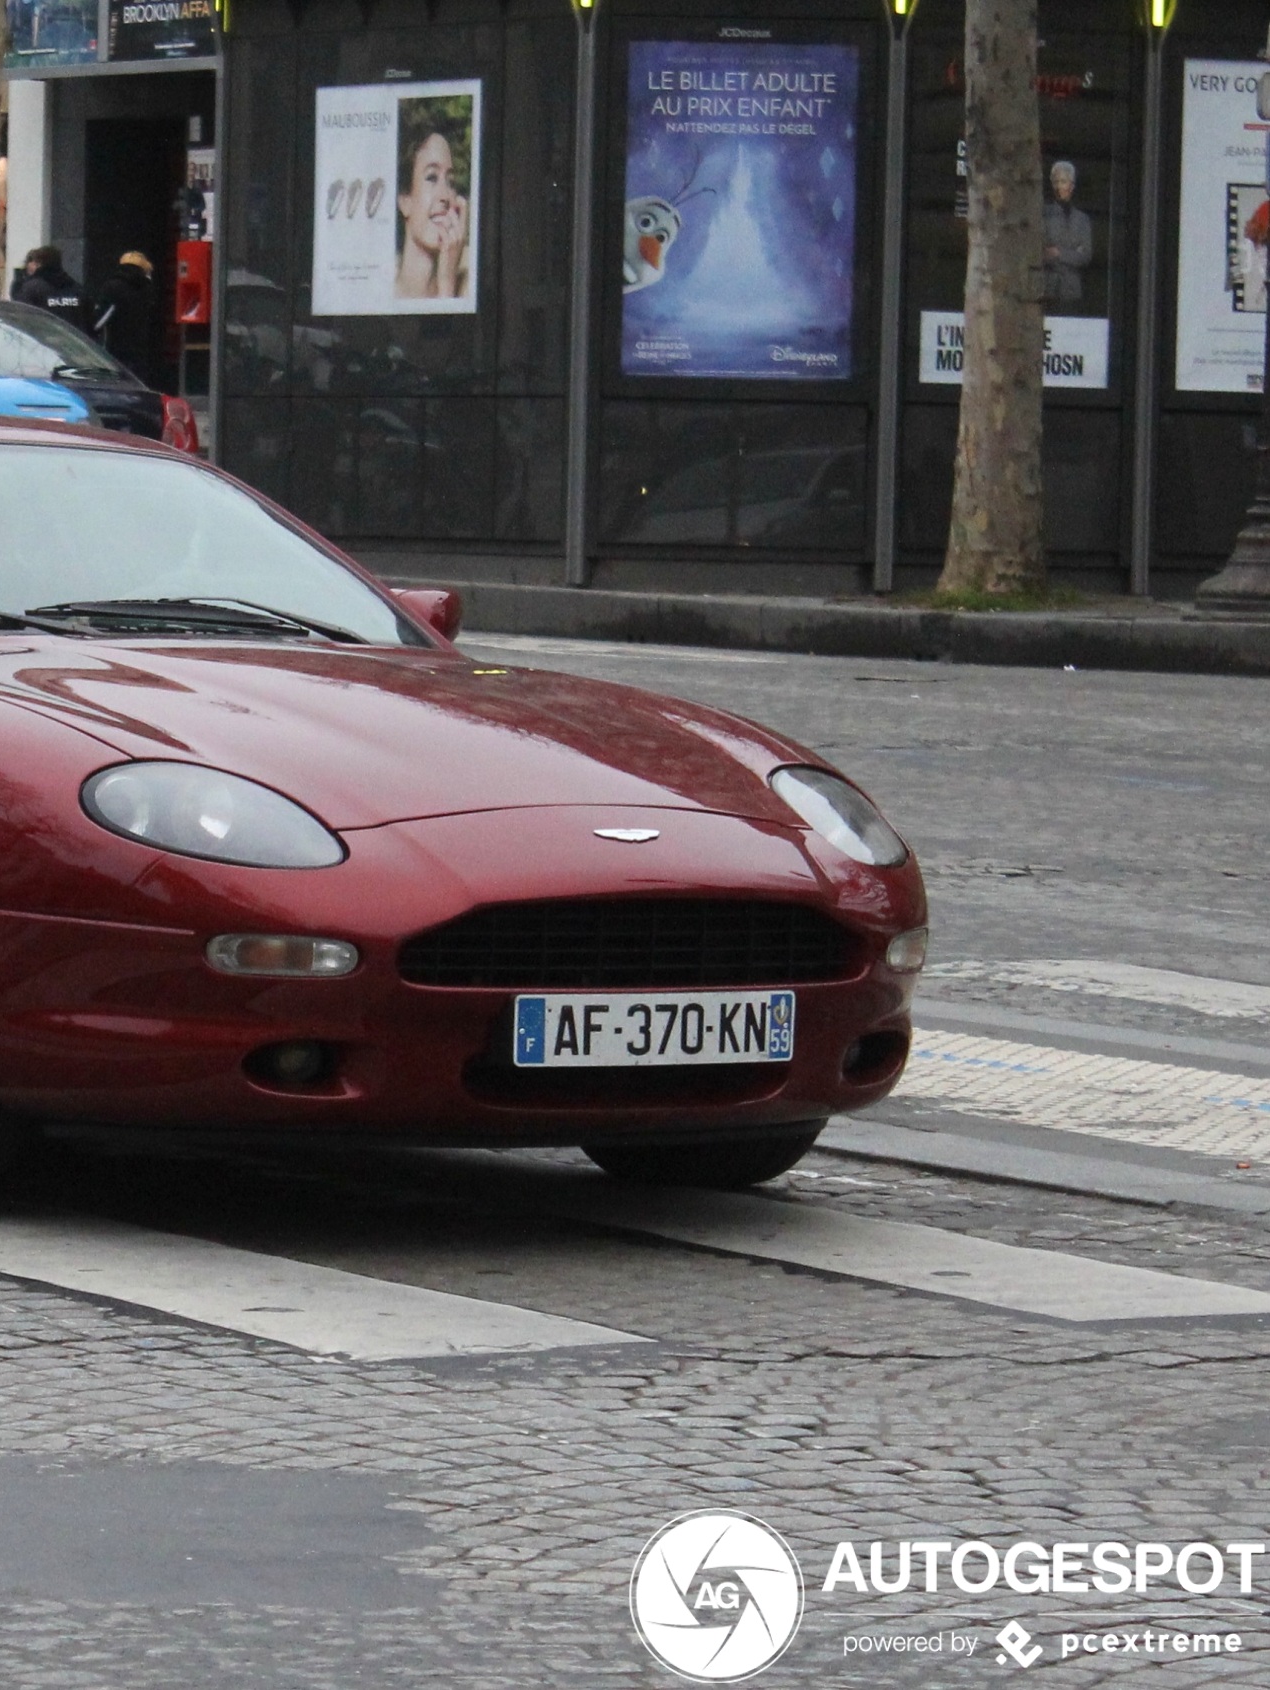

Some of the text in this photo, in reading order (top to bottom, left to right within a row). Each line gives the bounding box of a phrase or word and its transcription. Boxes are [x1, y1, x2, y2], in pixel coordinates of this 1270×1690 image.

[123, 3, 181, 24] BROOKLYN
[648, 71, 837, 93] LE BILLET ADULTE
[1190, 74, 1228, 92] VERY
[651, 97, 680, 116] AU
[687, 97, 733, 117] PRIX
[322, 111, 391, 129] MAUBOUSSIN
[739, 122, 759, 134] PAS
[762, 123, 776, 135] LE
[1042, 354, 1083, 376] HOSN
[554, 1002, 791, 1056] AF-370-KN 59
[525, 1037, 536, 1053] F
